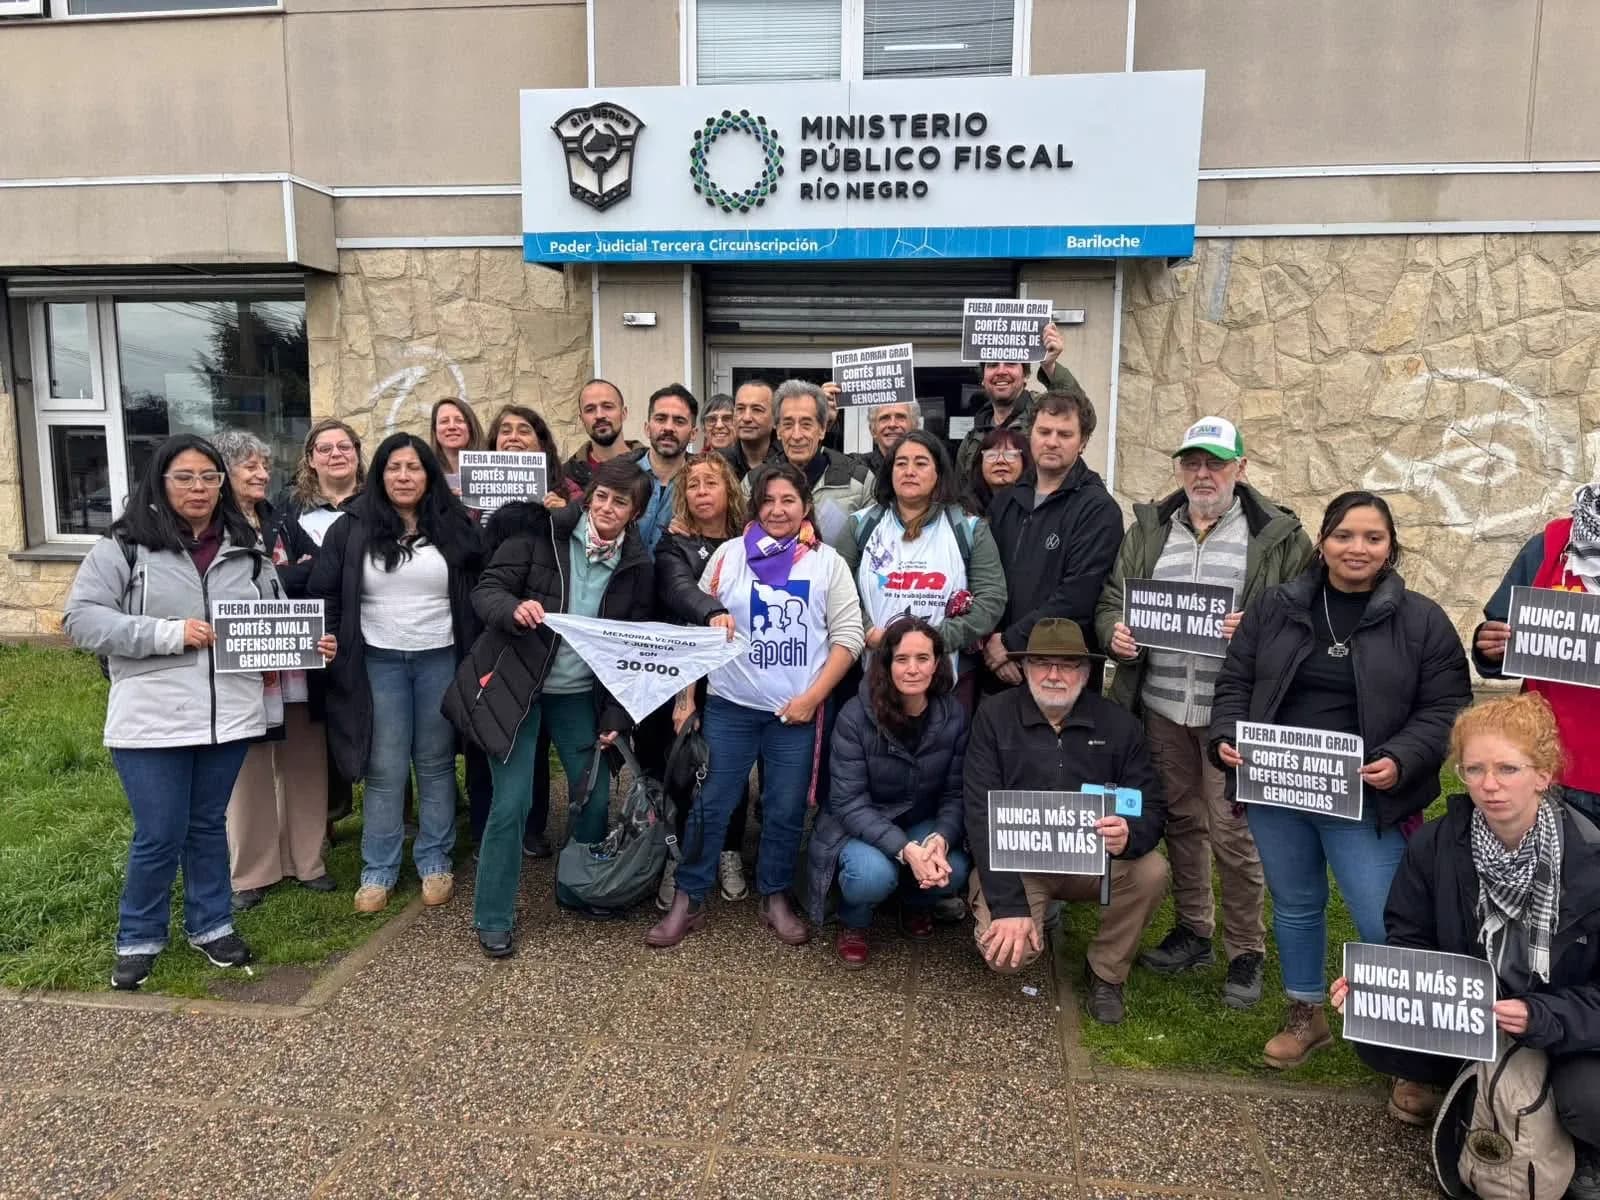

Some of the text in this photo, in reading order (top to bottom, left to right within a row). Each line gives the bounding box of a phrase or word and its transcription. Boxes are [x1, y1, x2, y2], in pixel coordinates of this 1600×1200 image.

[801, 112, 988, 140] MINISTERIO
[800, 142, 1074, 172] PÚBLICO FISCAL
[800, 177, 929, 200] RÍO NEGRO
[550, 238, 818, 254] Poder Judicial Tercera Circunscripción
[1066, 233, 1141, 249] Bariloche
[968, 302, 1048, 314] FUERA ADRIAN GRAU
[975, 317, 1039, 333] CORTÉS AVALA
[971, 334, 1041, 347] DEFENSORES DE
[836, 347, 909, 364] FUERA ADRIAN GRAU
[980, 347, 1030, 360] GENOCIDAS
[843, 364, 902, 380] CORTÉS AVALA
[841, 377, 906, 392] DEFENSORES DE
[851, 391, 897, 404] GENOCIDAS
[463, 454, 543, 465] FUERA ADRIAN GRAU
[471, 468, 535, 482] CORTÉS AVALA
[469, 483, 538, 495] DEFENSORES DE
[218, 603, 320, 615] FUERA ADRIAN GRAU
[1131, 590, 1226, 614] NUNCA MÁS ES
[229, 619, 310, 636] CORTÉS AVALA
[1129, 608, 1224, 639] NUNCA MÁS
[1518, 605, 1600, 634] NUNCA M
[226, 636, 313, 652] DEFENSORES DE
[631, 642, 675, 651] JUSTICIA
[655, 637, 697, 647] VERDAD
[1515, 631, 1587, 663] NUNCA
[239, 653, 301, 668] GENOCIDAS
[749, 637, 808, 669] apdh
[616, 660, 680, 677] 30.000
[1242, 726, 1358, 753] FUERA ADRIAN GRAU
[1252, 750, 1344, 777] CORTÉS AVALA
[1249, 766, 1349, 795] DEFENSORES DE
[1263, 785, 1333, 811] GENOCIDAS
[997, 806, 1096, 827] NUNCA MÁS ES
[997, 828, 1097, 854] NUNCA MÁS
[1353, 963, 1484, 1000] NUNCA MÁS ES
[1353, 990, 1485, 1035] NUNCA MÁS
